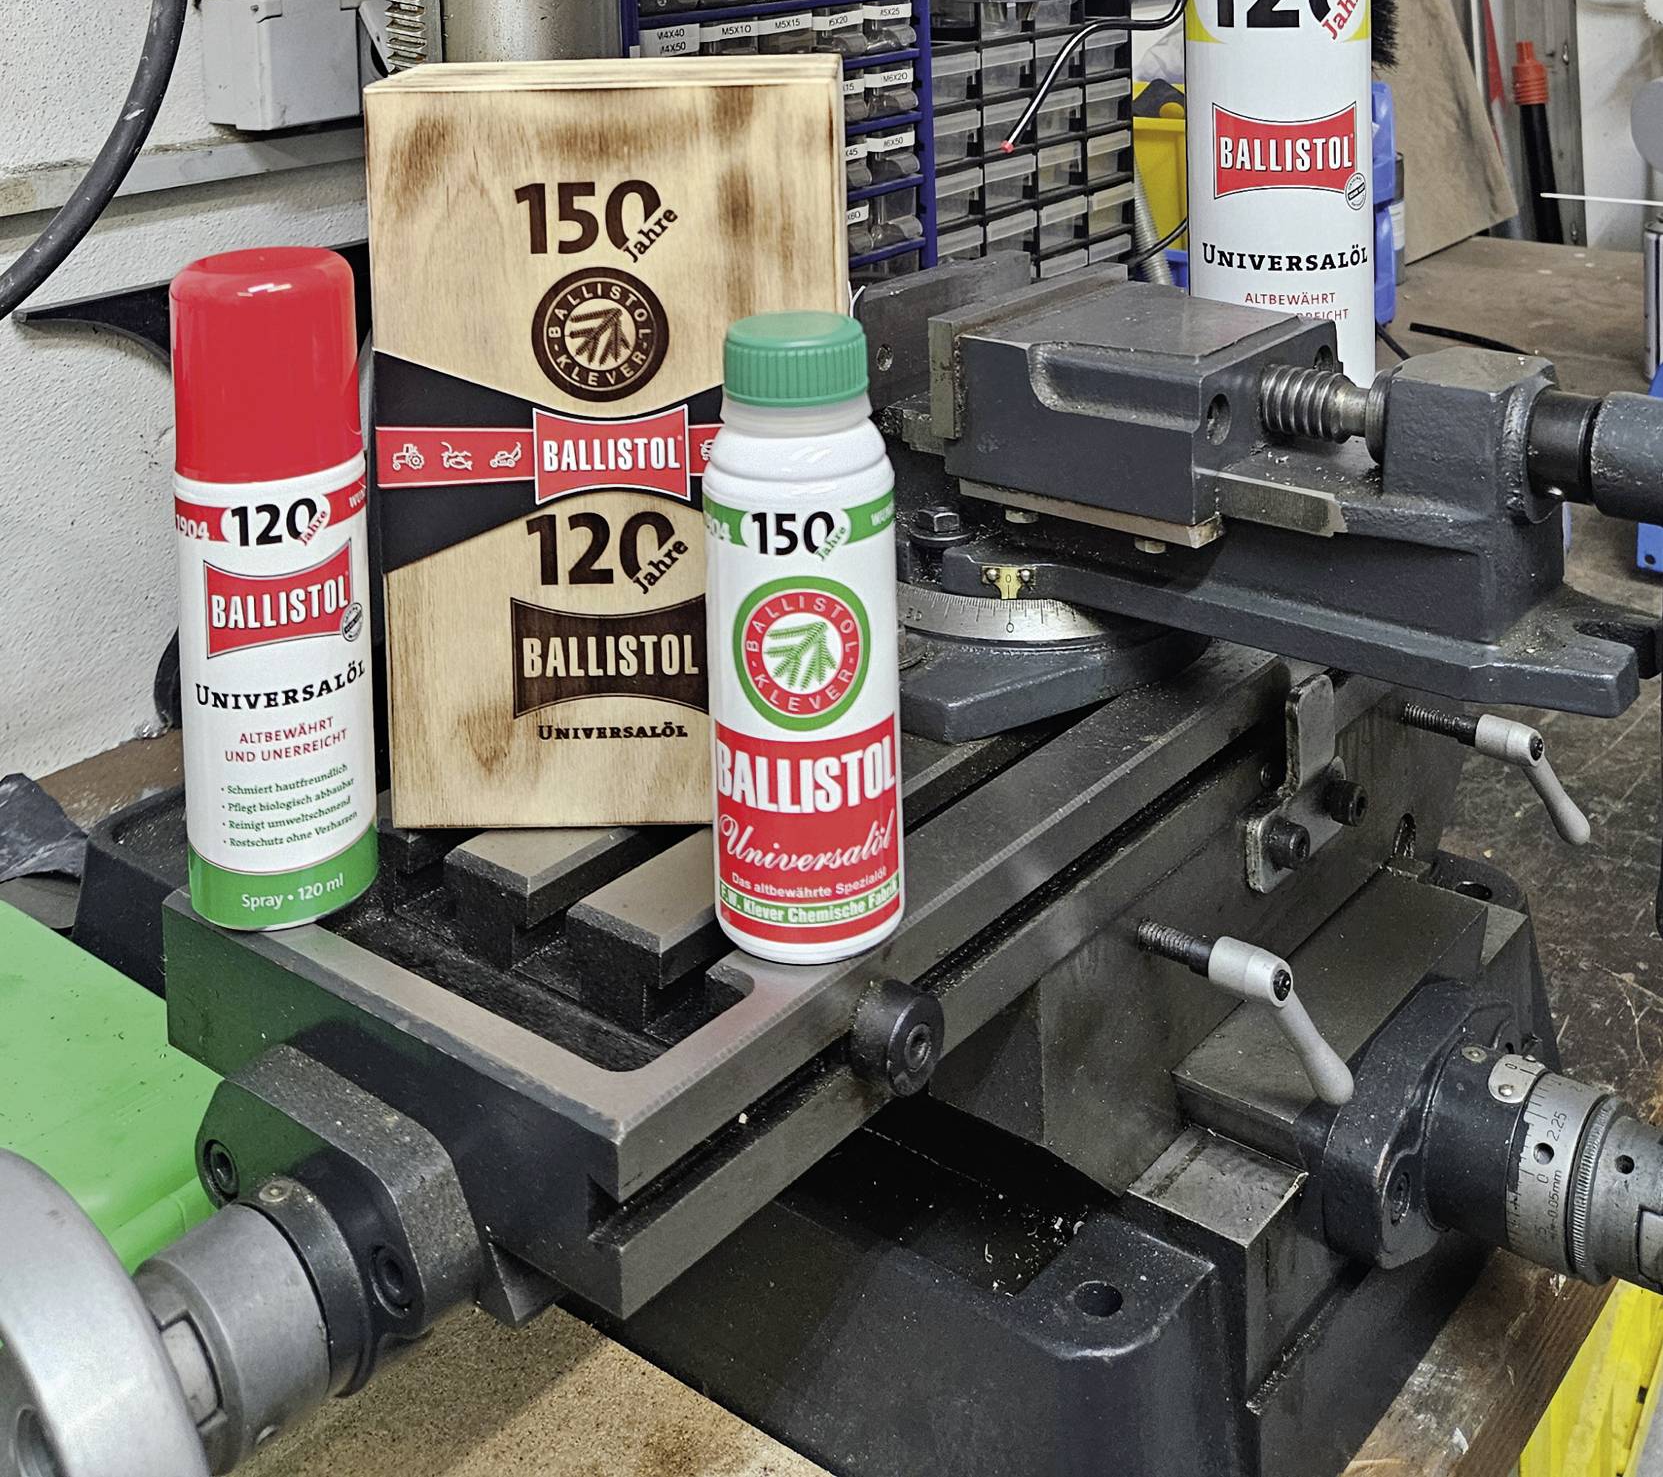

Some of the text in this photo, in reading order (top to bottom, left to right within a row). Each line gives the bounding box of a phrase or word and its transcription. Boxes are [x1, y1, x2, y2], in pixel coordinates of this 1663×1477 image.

[721, 24, 752, 36] M5X10
[774, 18, 801, 29] M5X15
[1219, 133, 1354, 174] BALLISTOL
[513, 178, 663, 256] 150
[622, 205, 679, 264] Jahre
[547, 283, 654, 341] BALLISTOL
[1244, 292, 1336, 306] ALTBEWÄHRT
[554, 350, 649, 387] KLEVER
[542, 436, 682, 473] BALLISTOL
[230, 497, 318, 547] 120
[300, 510, 328, 547] Jahre
[751, 510, 836, 556] 150
[525, 510, 676, 586] 120
[815, 525, 848, 561] Jahre
[631, 539, 689, 595] Jahre
[210, 575, 349, 630] BALLISTOL
[746, 594, 858, 653] BALLISTOL
[522, 634, 700, 679] BALLISTOL
[754, 669, 854, 712] KLEVER
[224, 728, 348, 763] UND UNERREICHT
[239, 715, 335, 745] ALTBEWÄHRT
[227, 763, 348, 795] Schmiert hautfreundlich
[716, 734, 896, 814] BALLISTOL
[227, 777, 355, 815] Pflegt biologisch abbaubar
[228, 795, 352, 832] Reinigt umweltschonend
[229, 810, 358, 847] Rostschutz ohne Verharzen
[719, 806, 896, 873] Universalöl
[241, 872, 345, 912] Spray 120 ml
[731, 865, 888, 899] Das altbewährte Spezialöl
[743, 898, 785, 923] Klever
[787, 899, 866, 924] Chemische
[867, 879, 899, 909] Fabrik
[1546, 1110, 1568, 1142] 2.25
